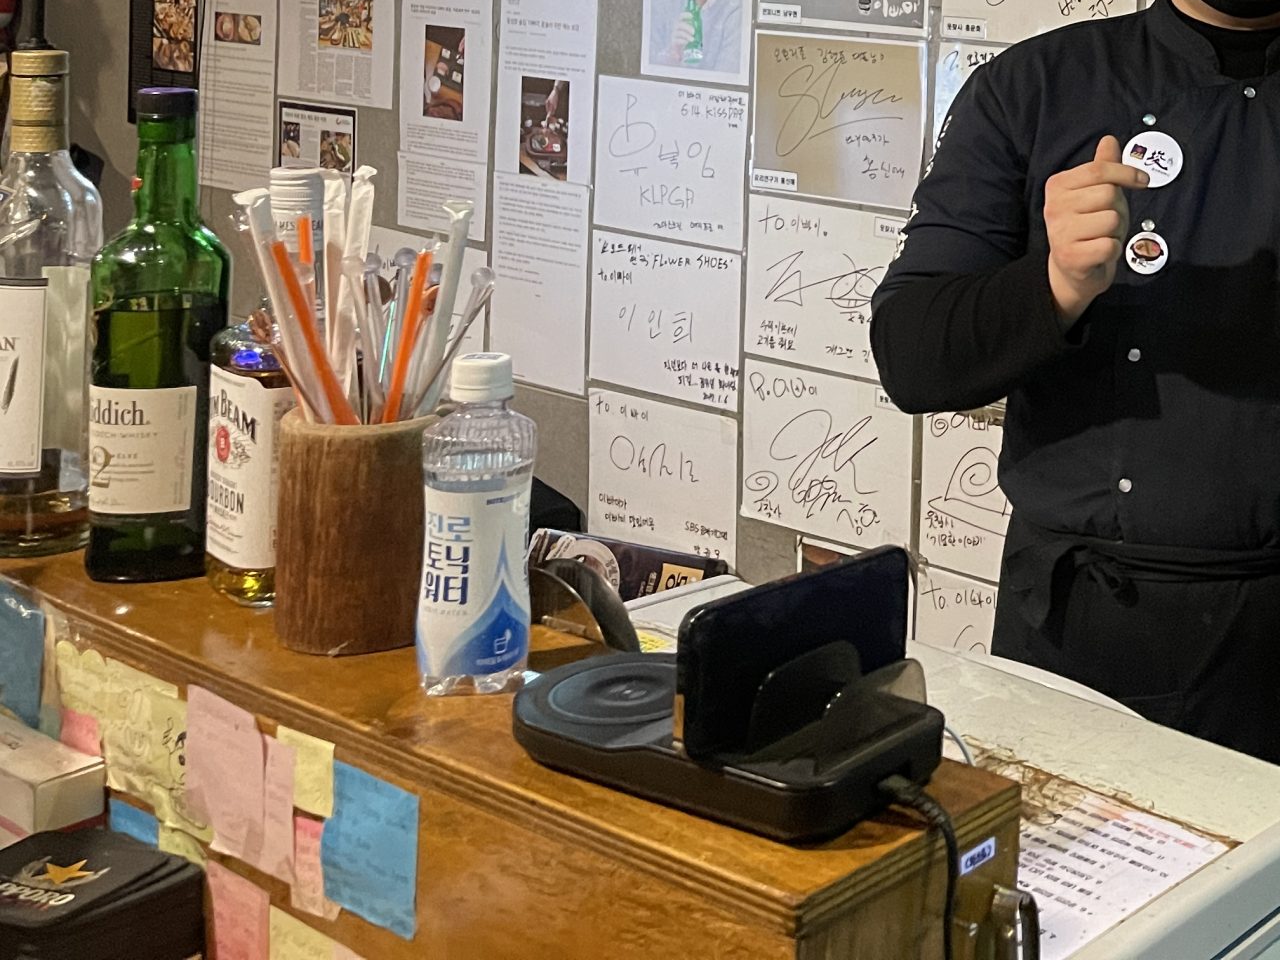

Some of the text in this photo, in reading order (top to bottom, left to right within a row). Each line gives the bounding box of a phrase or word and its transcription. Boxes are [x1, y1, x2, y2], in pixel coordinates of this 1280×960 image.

[640, 184, 695, 209] KLPGA
[220, 388, 258, 440] BEAM
[427, 512, 473, 543] 진로
[684, 520, 700, 534] SBS
[429, 542, 470, 576] 토닉
[425, 573, 469, 606] 워터
